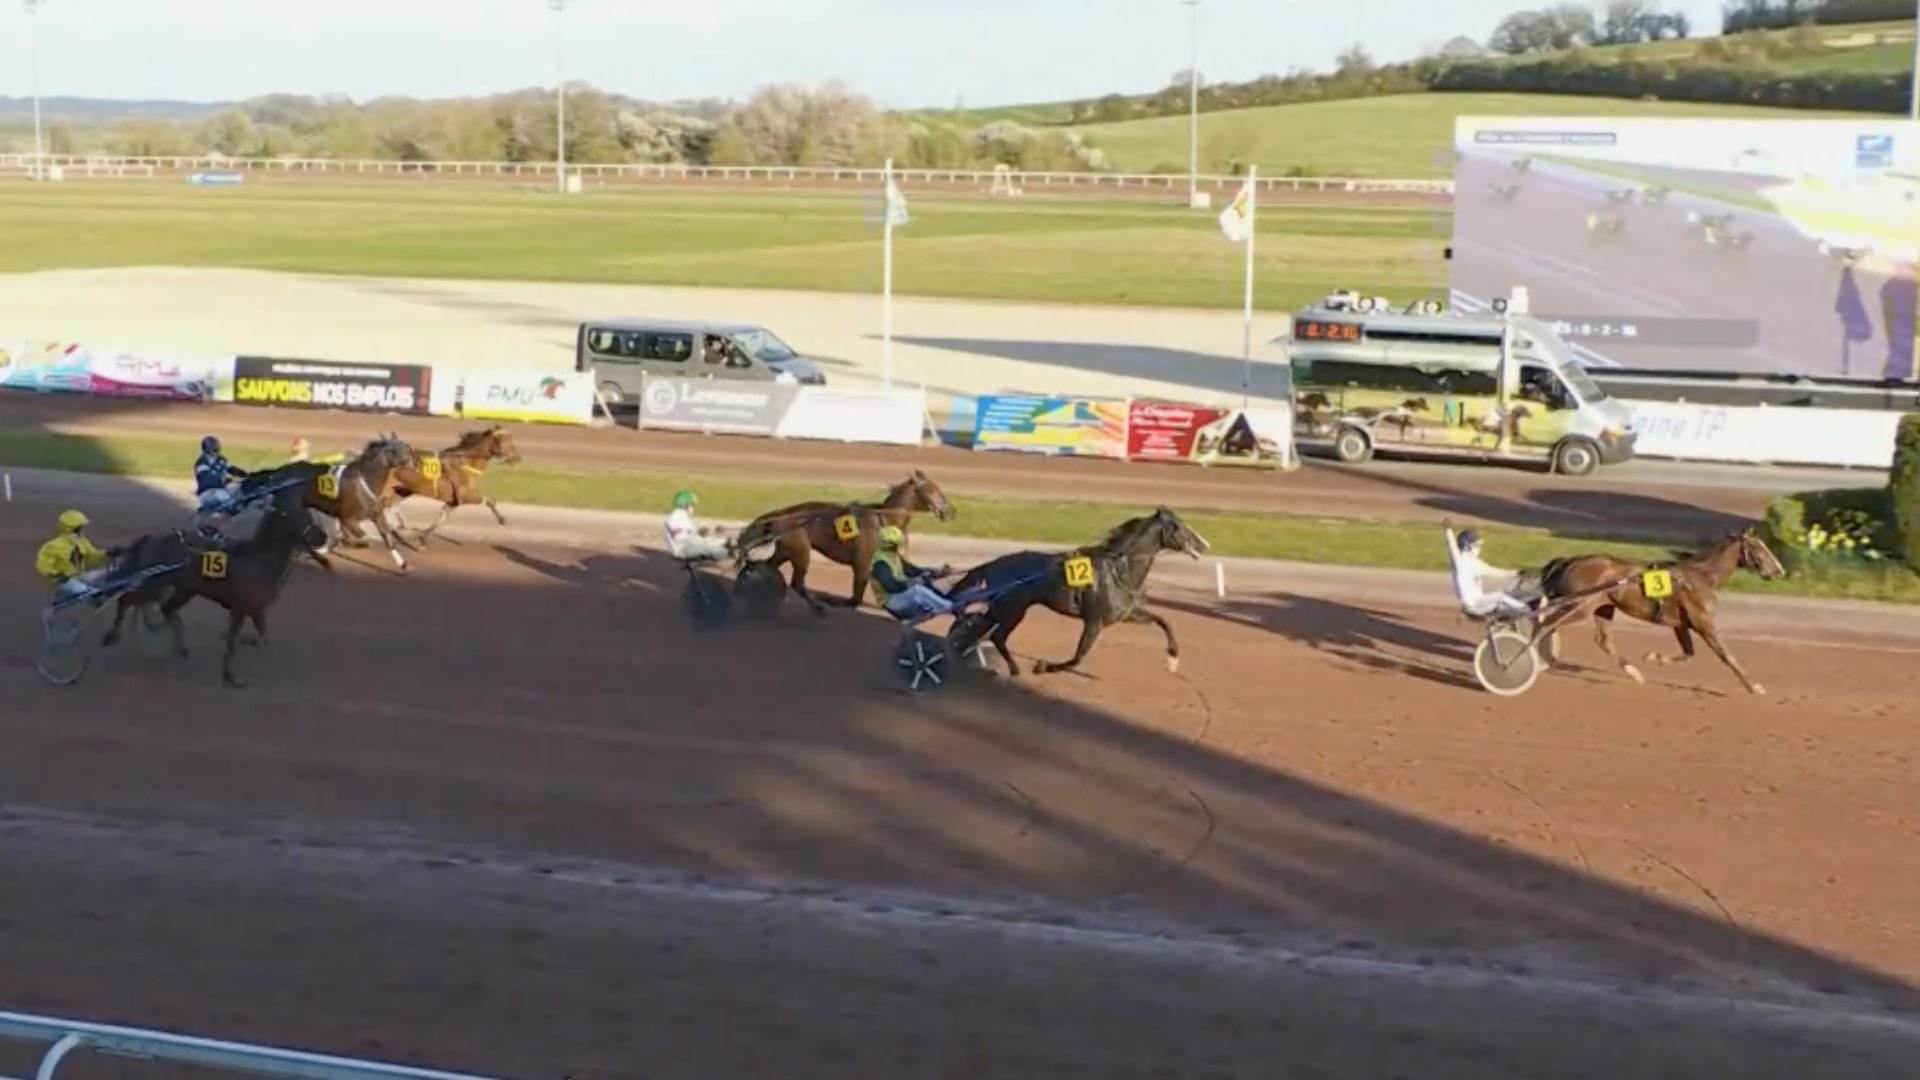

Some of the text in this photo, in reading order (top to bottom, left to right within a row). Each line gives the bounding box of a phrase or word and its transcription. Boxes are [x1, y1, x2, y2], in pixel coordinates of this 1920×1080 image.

[236, 377, 312, 402] SAUVONS
[312, 381, 345, 404] NOS
[347, 384, 415, 409] EMPLOIS
[487, 384, 534, 405] PMU
[1697, 409, 1727, 439] TP
[424, 461, 437, 475] 10
[321, 477, 335, 491] 13
[842, 519, 853, 533] 4
[206, 554, 224, 573] 15
[1068, 562, 1090, 580] 12
[1652, 575, 1664, 592] 3
